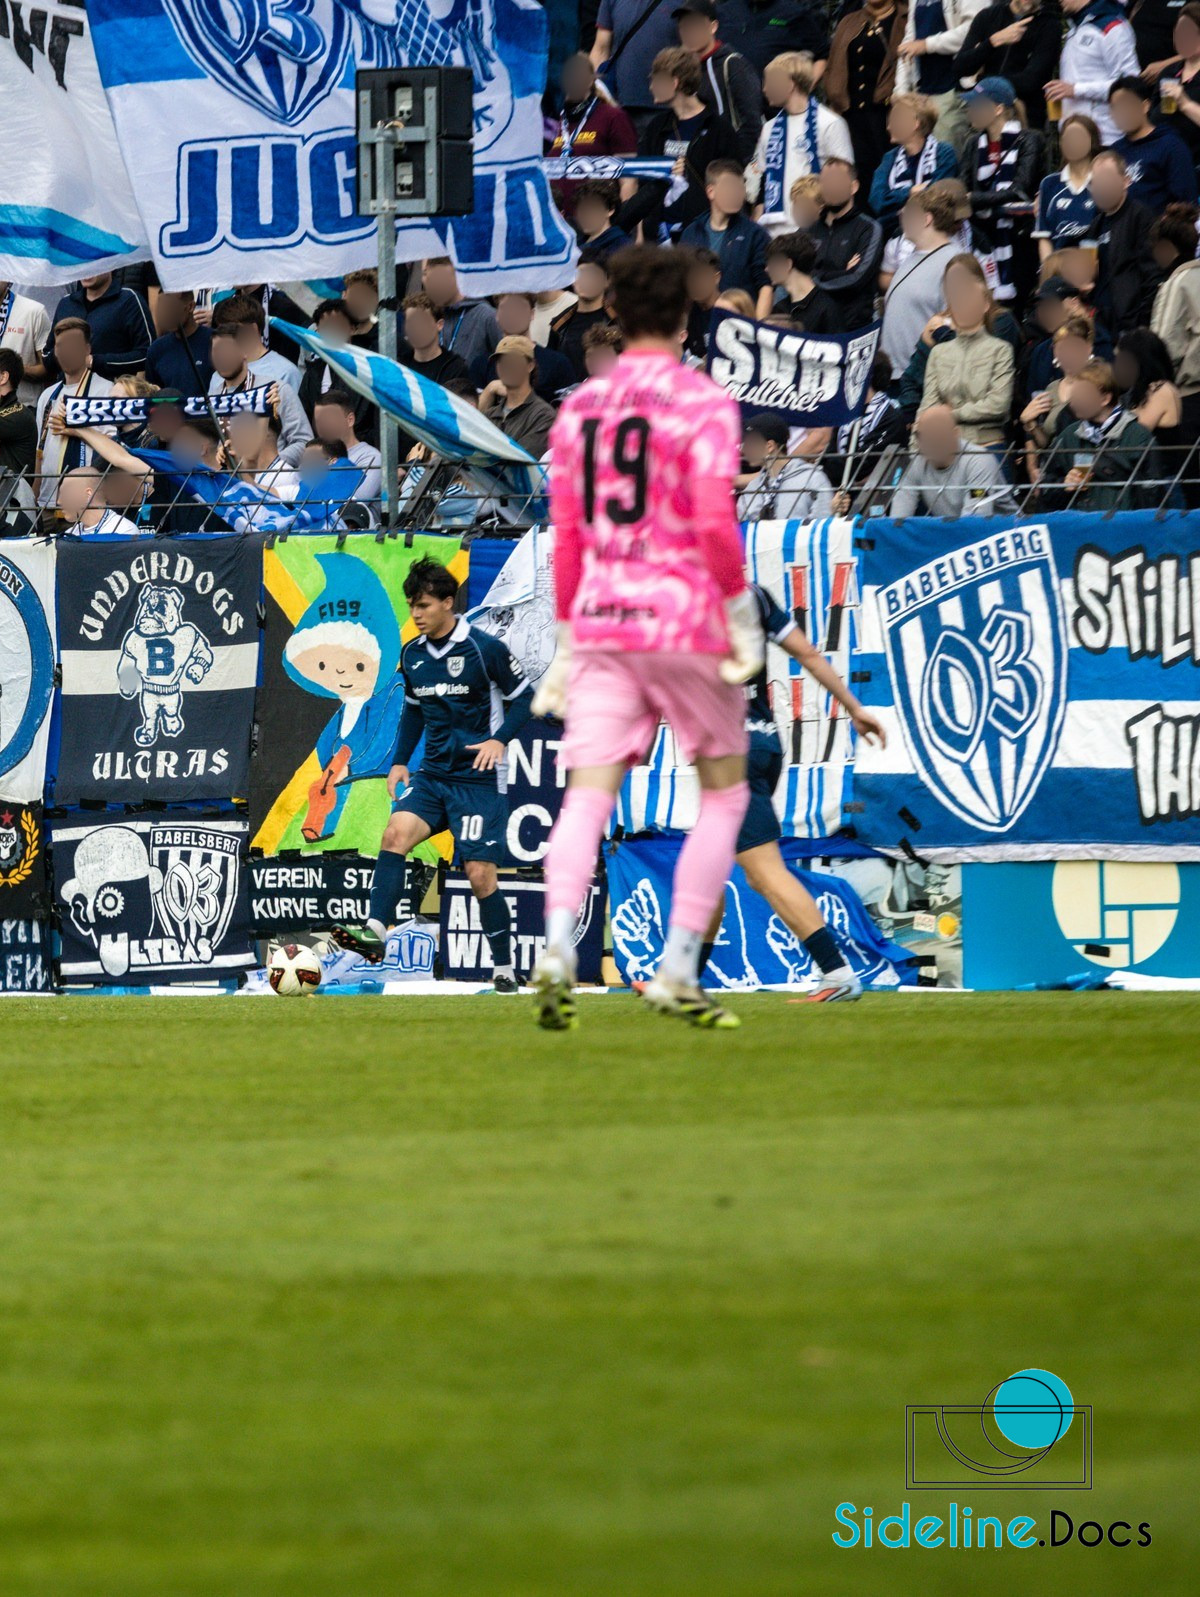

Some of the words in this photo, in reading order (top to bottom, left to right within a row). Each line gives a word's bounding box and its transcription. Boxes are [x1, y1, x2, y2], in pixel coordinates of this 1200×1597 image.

[711, 317, 844, 403] SVB
[65, 398, 148, 426] BRIC
[581, 416, 651, 524] 19
[885, 528, 1046, 617] BABELSBERG
[79, 552, 244, 641] UNDERDOGS
[146, 638, 176, 676] B
[447, 684, 470, 696] Liebe
[922, 601, 1044, 764] 03
[92, 748, 230, 783] ULTRAS
[154, 831, 238, 853] BABELSBERG
[460, 814, 484, 841] 10
[163, 861, 223, 927] 03
[253, 868, 327, 889] VEREIN.
[343, 868, 413, 889] STT.
[252, 897, 325, 920] KURVE.
[326, 898, 416, 920] GRUE.
[100, 932, 214, 976] ULTRAS
